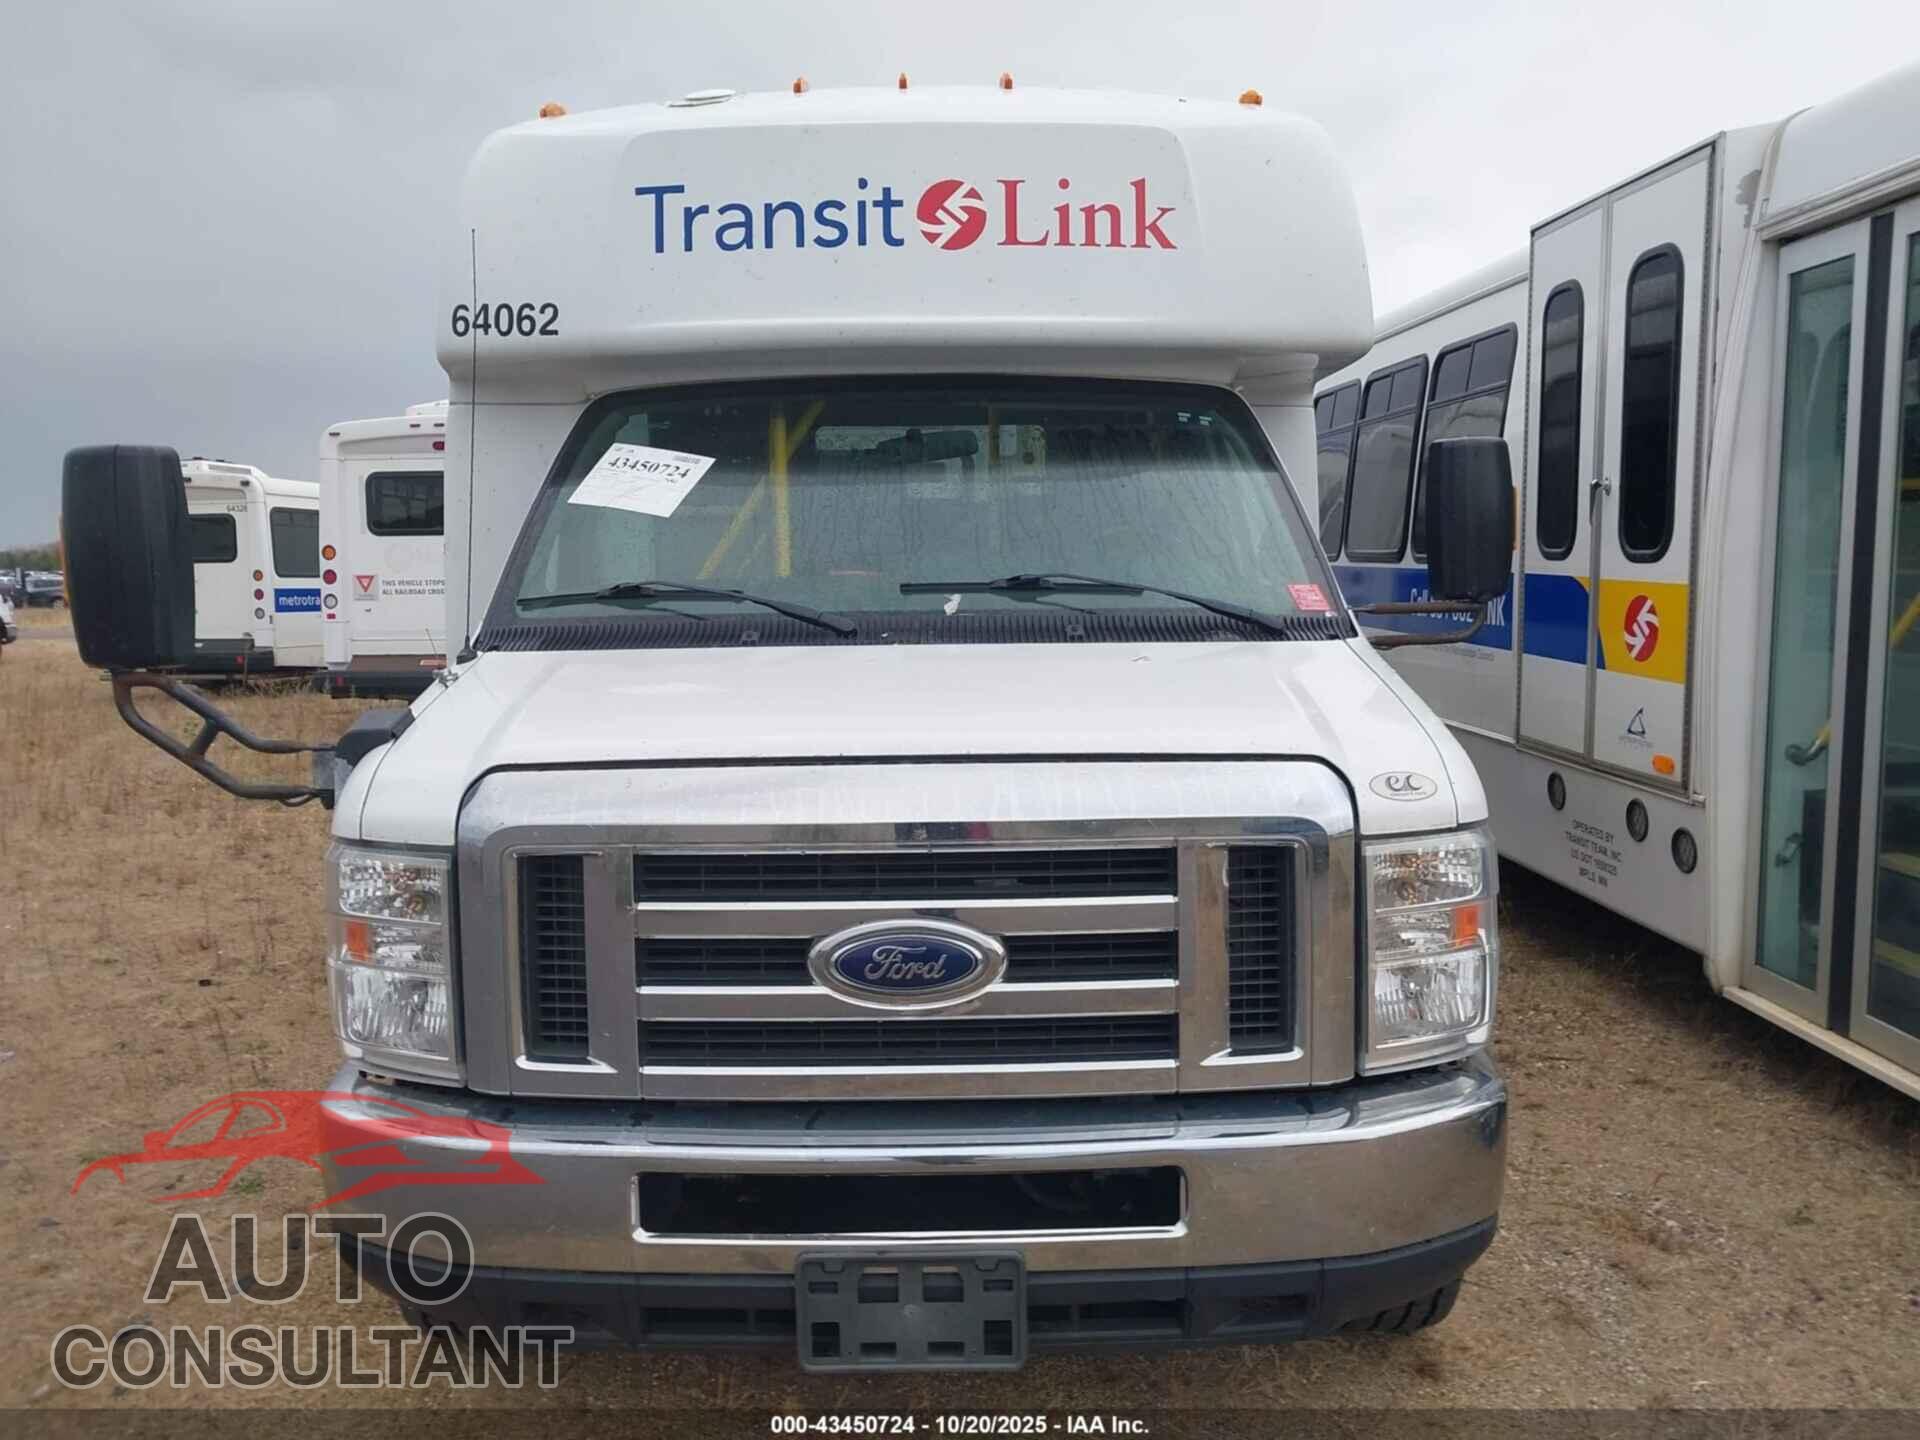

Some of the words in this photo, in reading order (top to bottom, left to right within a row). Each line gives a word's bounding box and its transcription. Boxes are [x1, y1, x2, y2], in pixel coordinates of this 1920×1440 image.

[635, 177, 904, 253] Transit
[997, 177, 1177, 249] Link
[452, 302, 559, 337] 64062
[608, 456, 692, 479] 43450724
[864, 945, 948, 980] Ford
